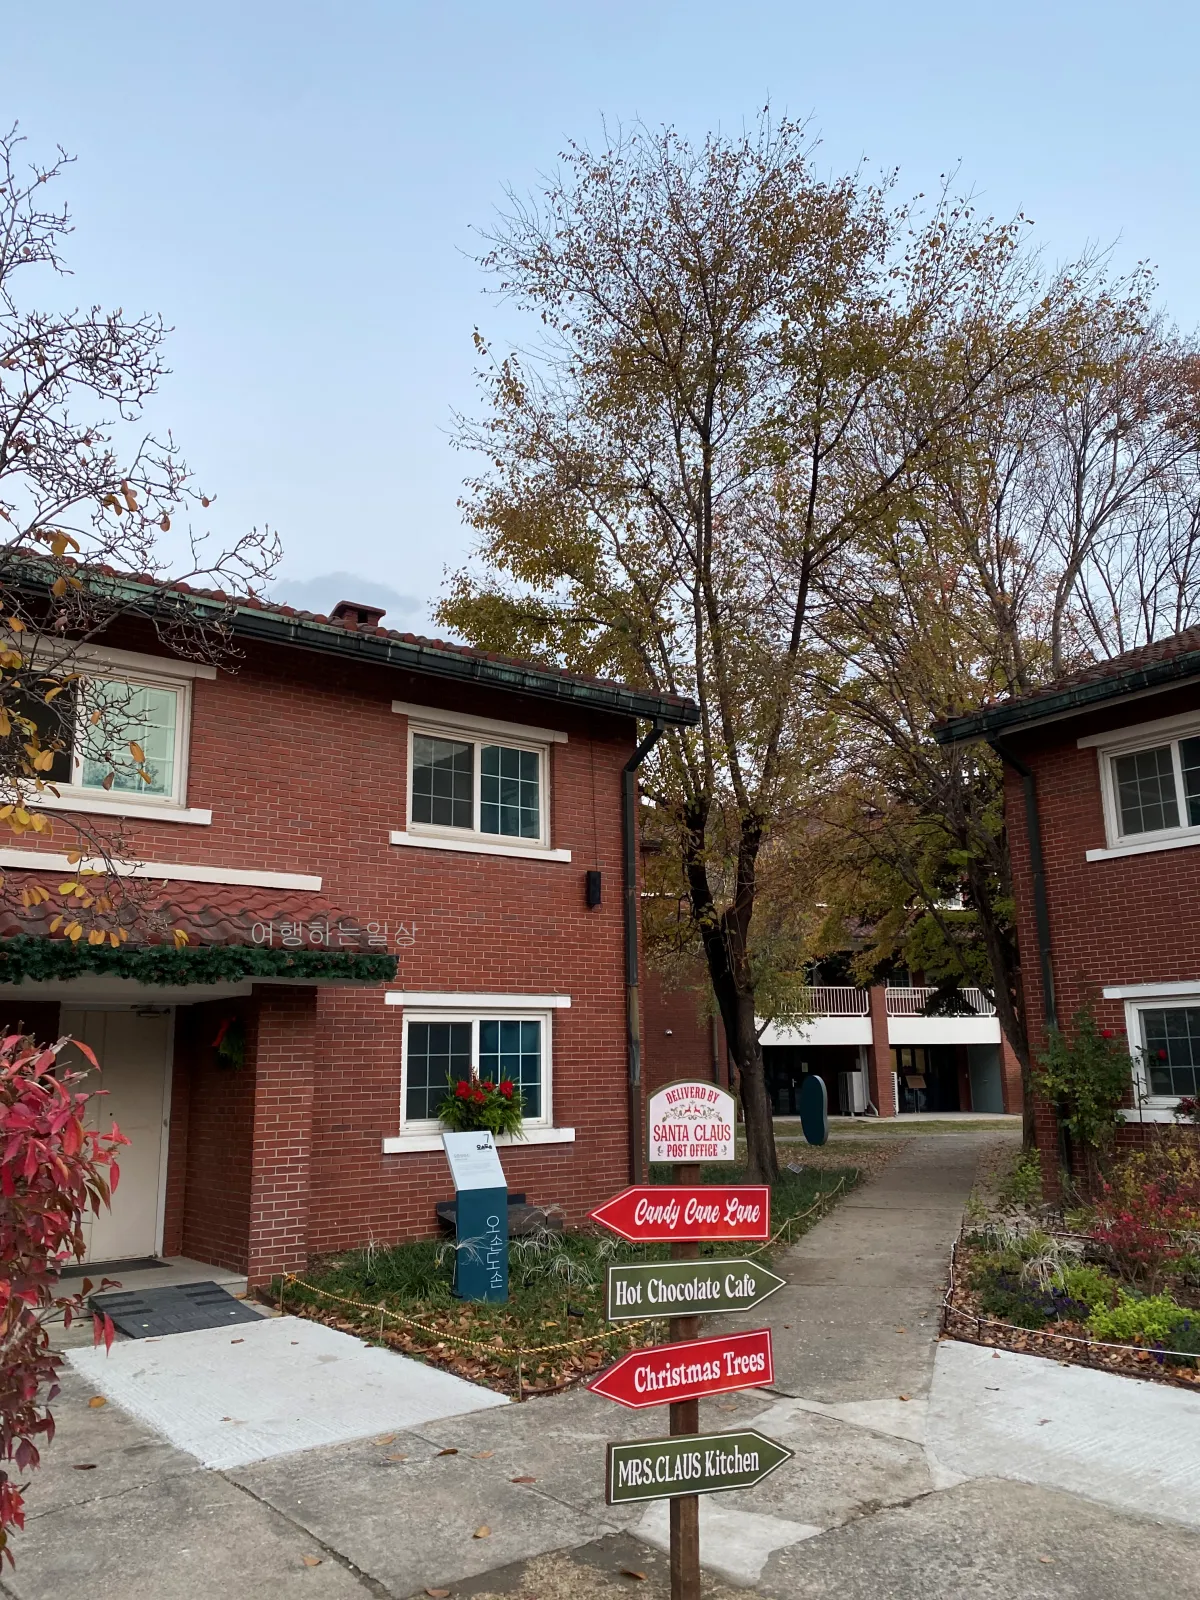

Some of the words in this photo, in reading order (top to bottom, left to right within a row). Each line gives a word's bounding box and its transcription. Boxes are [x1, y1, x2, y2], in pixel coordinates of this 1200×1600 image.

[665, 1086, 706, 1104] DELIVERD
[707, 1089, 720, 1104] BY
[653, 1125, 689, 1142] SANTA
[694, 1124, 731, 1141] CLAUS
[667, 1144, 689, 1157] POST
[689, 1143, 718, 1157] OFFICE
[634, 1198, 679, 1229] Candy
[684, 1198, 720, 1225] Cane
[723, 1197, 760, 1226] Lane
[486, 1215, 503, 1289] 오손도손
[616, 1281, 642, 1305] Hot
[647, 1277, 720, 1304] Chocolate
[724, 1273, 756, 1298] Cafe
[634, 1359, 721, 1393] Christmas
[723, 1352, 765, 1376] Trees
[618, 1452, 702, 1487] MRS.CLAUS
[705, 1445, 759, 1477] Kitchen
